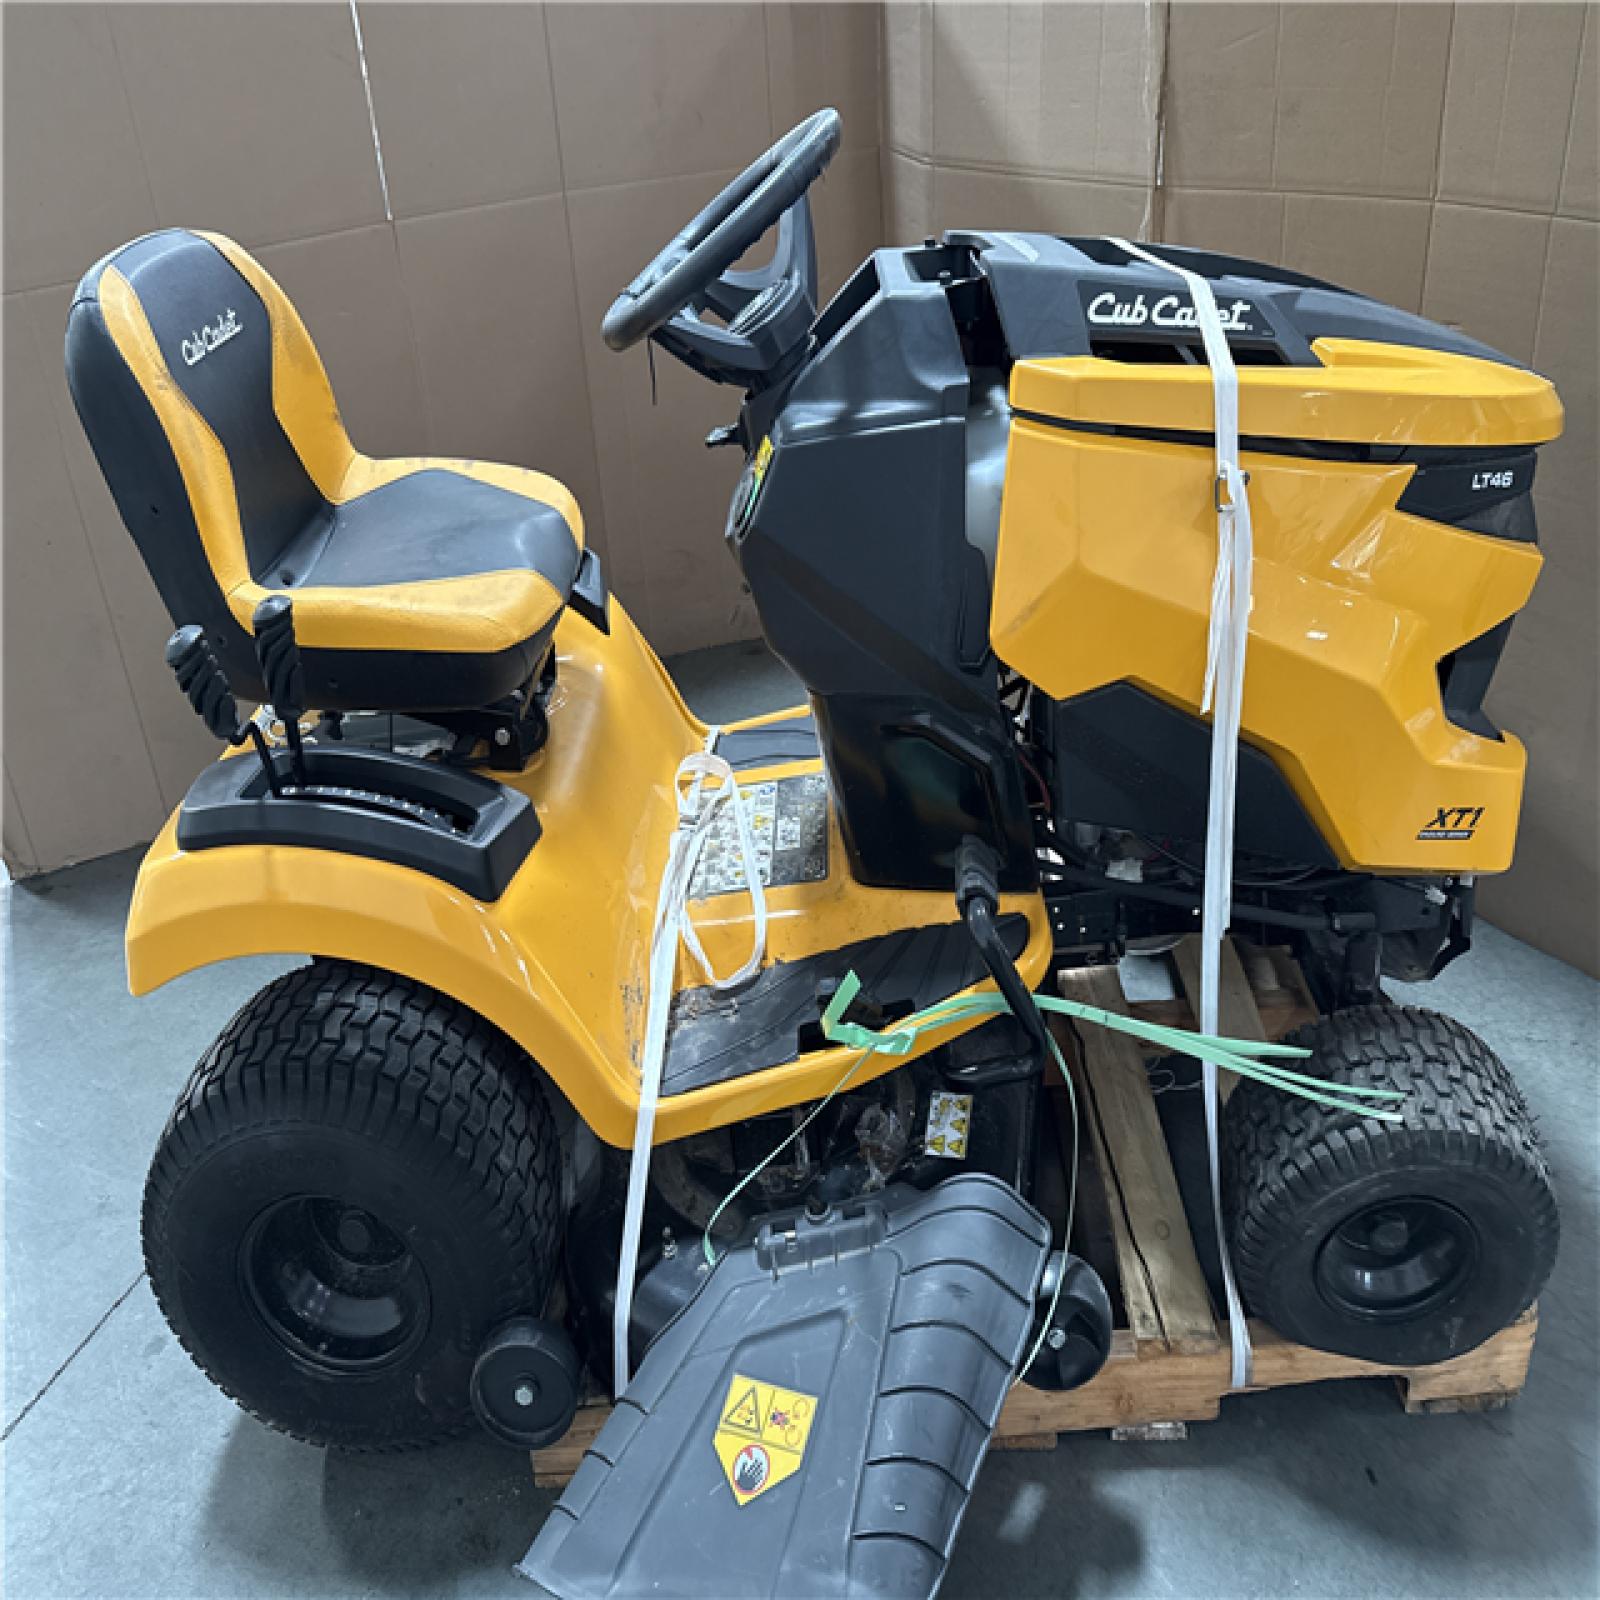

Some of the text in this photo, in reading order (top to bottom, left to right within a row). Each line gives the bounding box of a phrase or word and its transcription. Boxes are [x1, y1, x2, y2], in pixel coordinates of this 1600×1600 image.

[1087, 292, 1251, 331] Cub Caet
[181, 330, 207, 366] Cub
[1472, 470, 1513, 491] LT46
[1425, 807, 1486, 828] XT1
